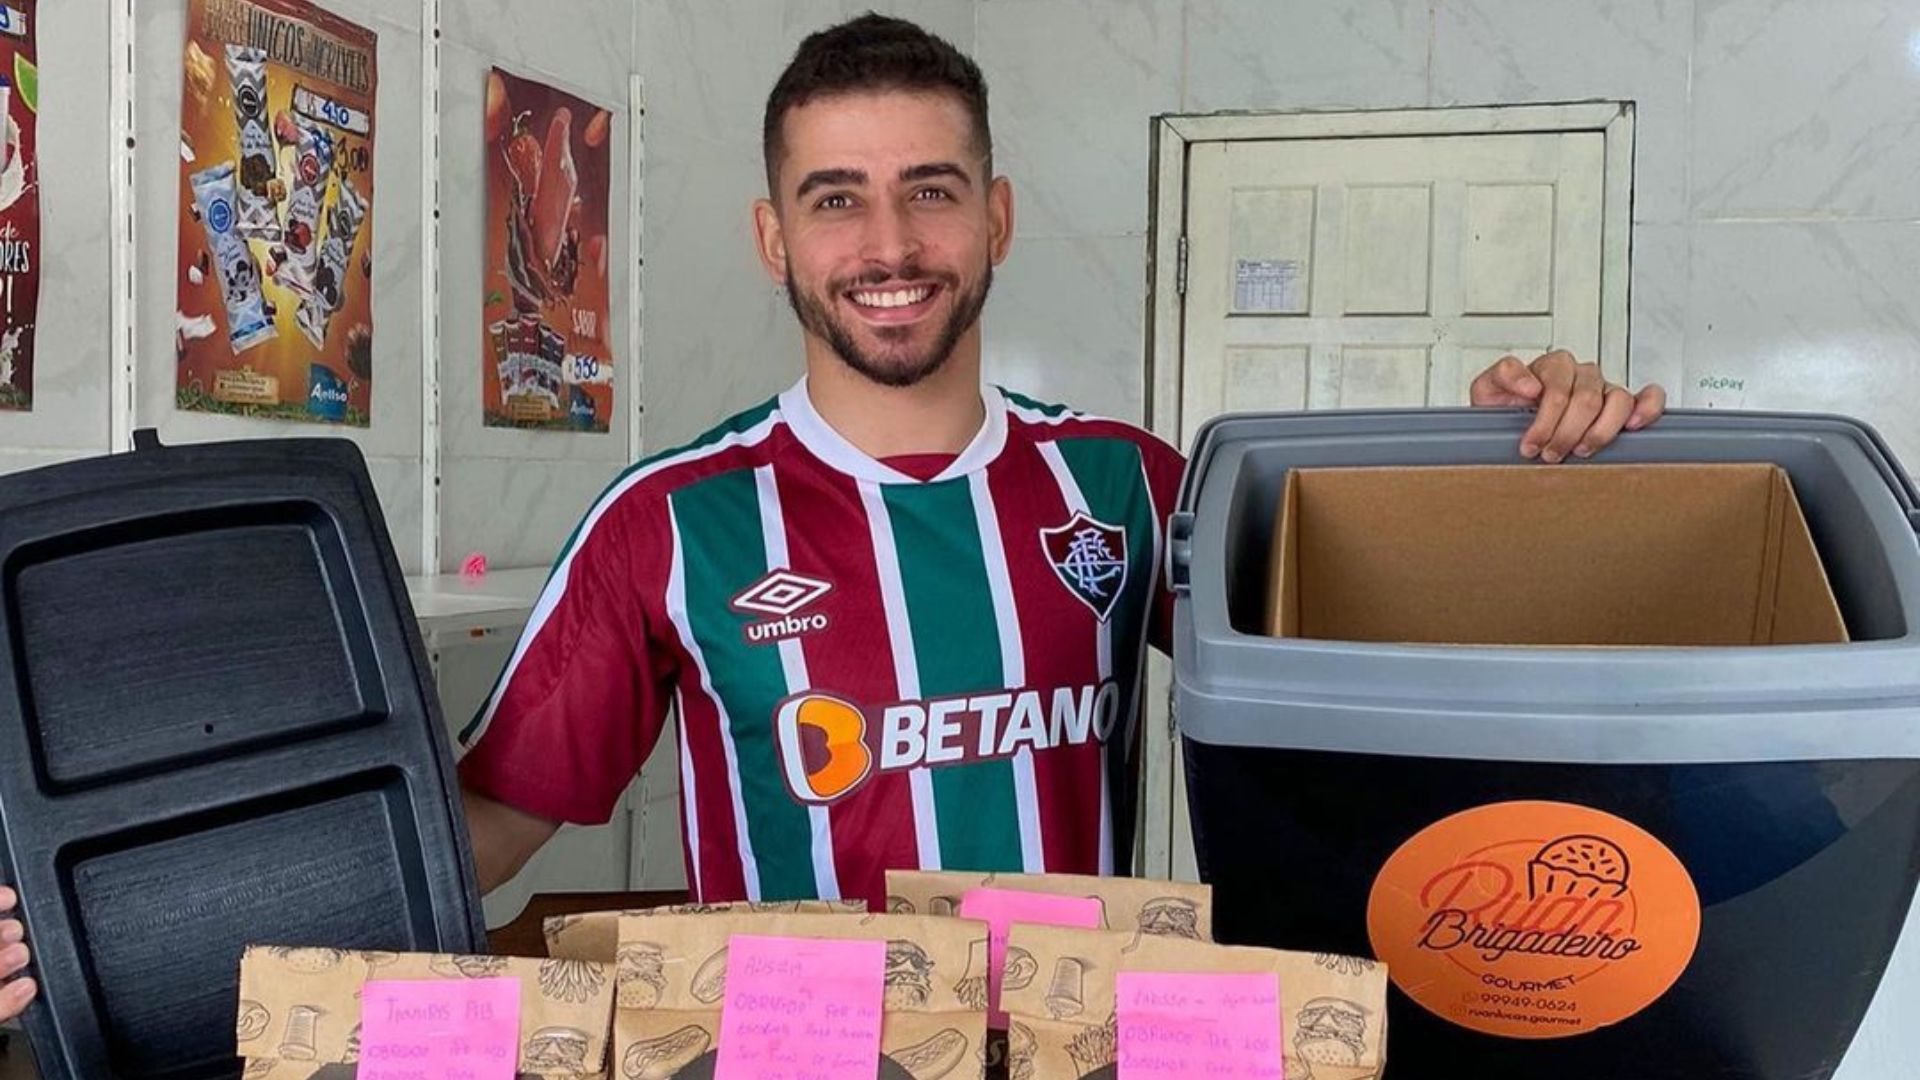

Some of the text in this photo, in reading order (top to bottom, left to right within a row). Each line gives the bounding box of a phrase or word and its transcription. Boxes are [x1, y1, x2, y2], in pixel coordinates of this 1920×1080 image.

[748, 614, 828, 641] umbro
[880, 681, 1119, 770] BETANO
[1418, 908, 1642, 961] Brigadeiro
[1482, 973, 1576, 992] GOURMET
[1480, 993, 1577, 1012] 99949-0624
[1468, 1008, 1582, 1026] ruanlucas.gourmet
